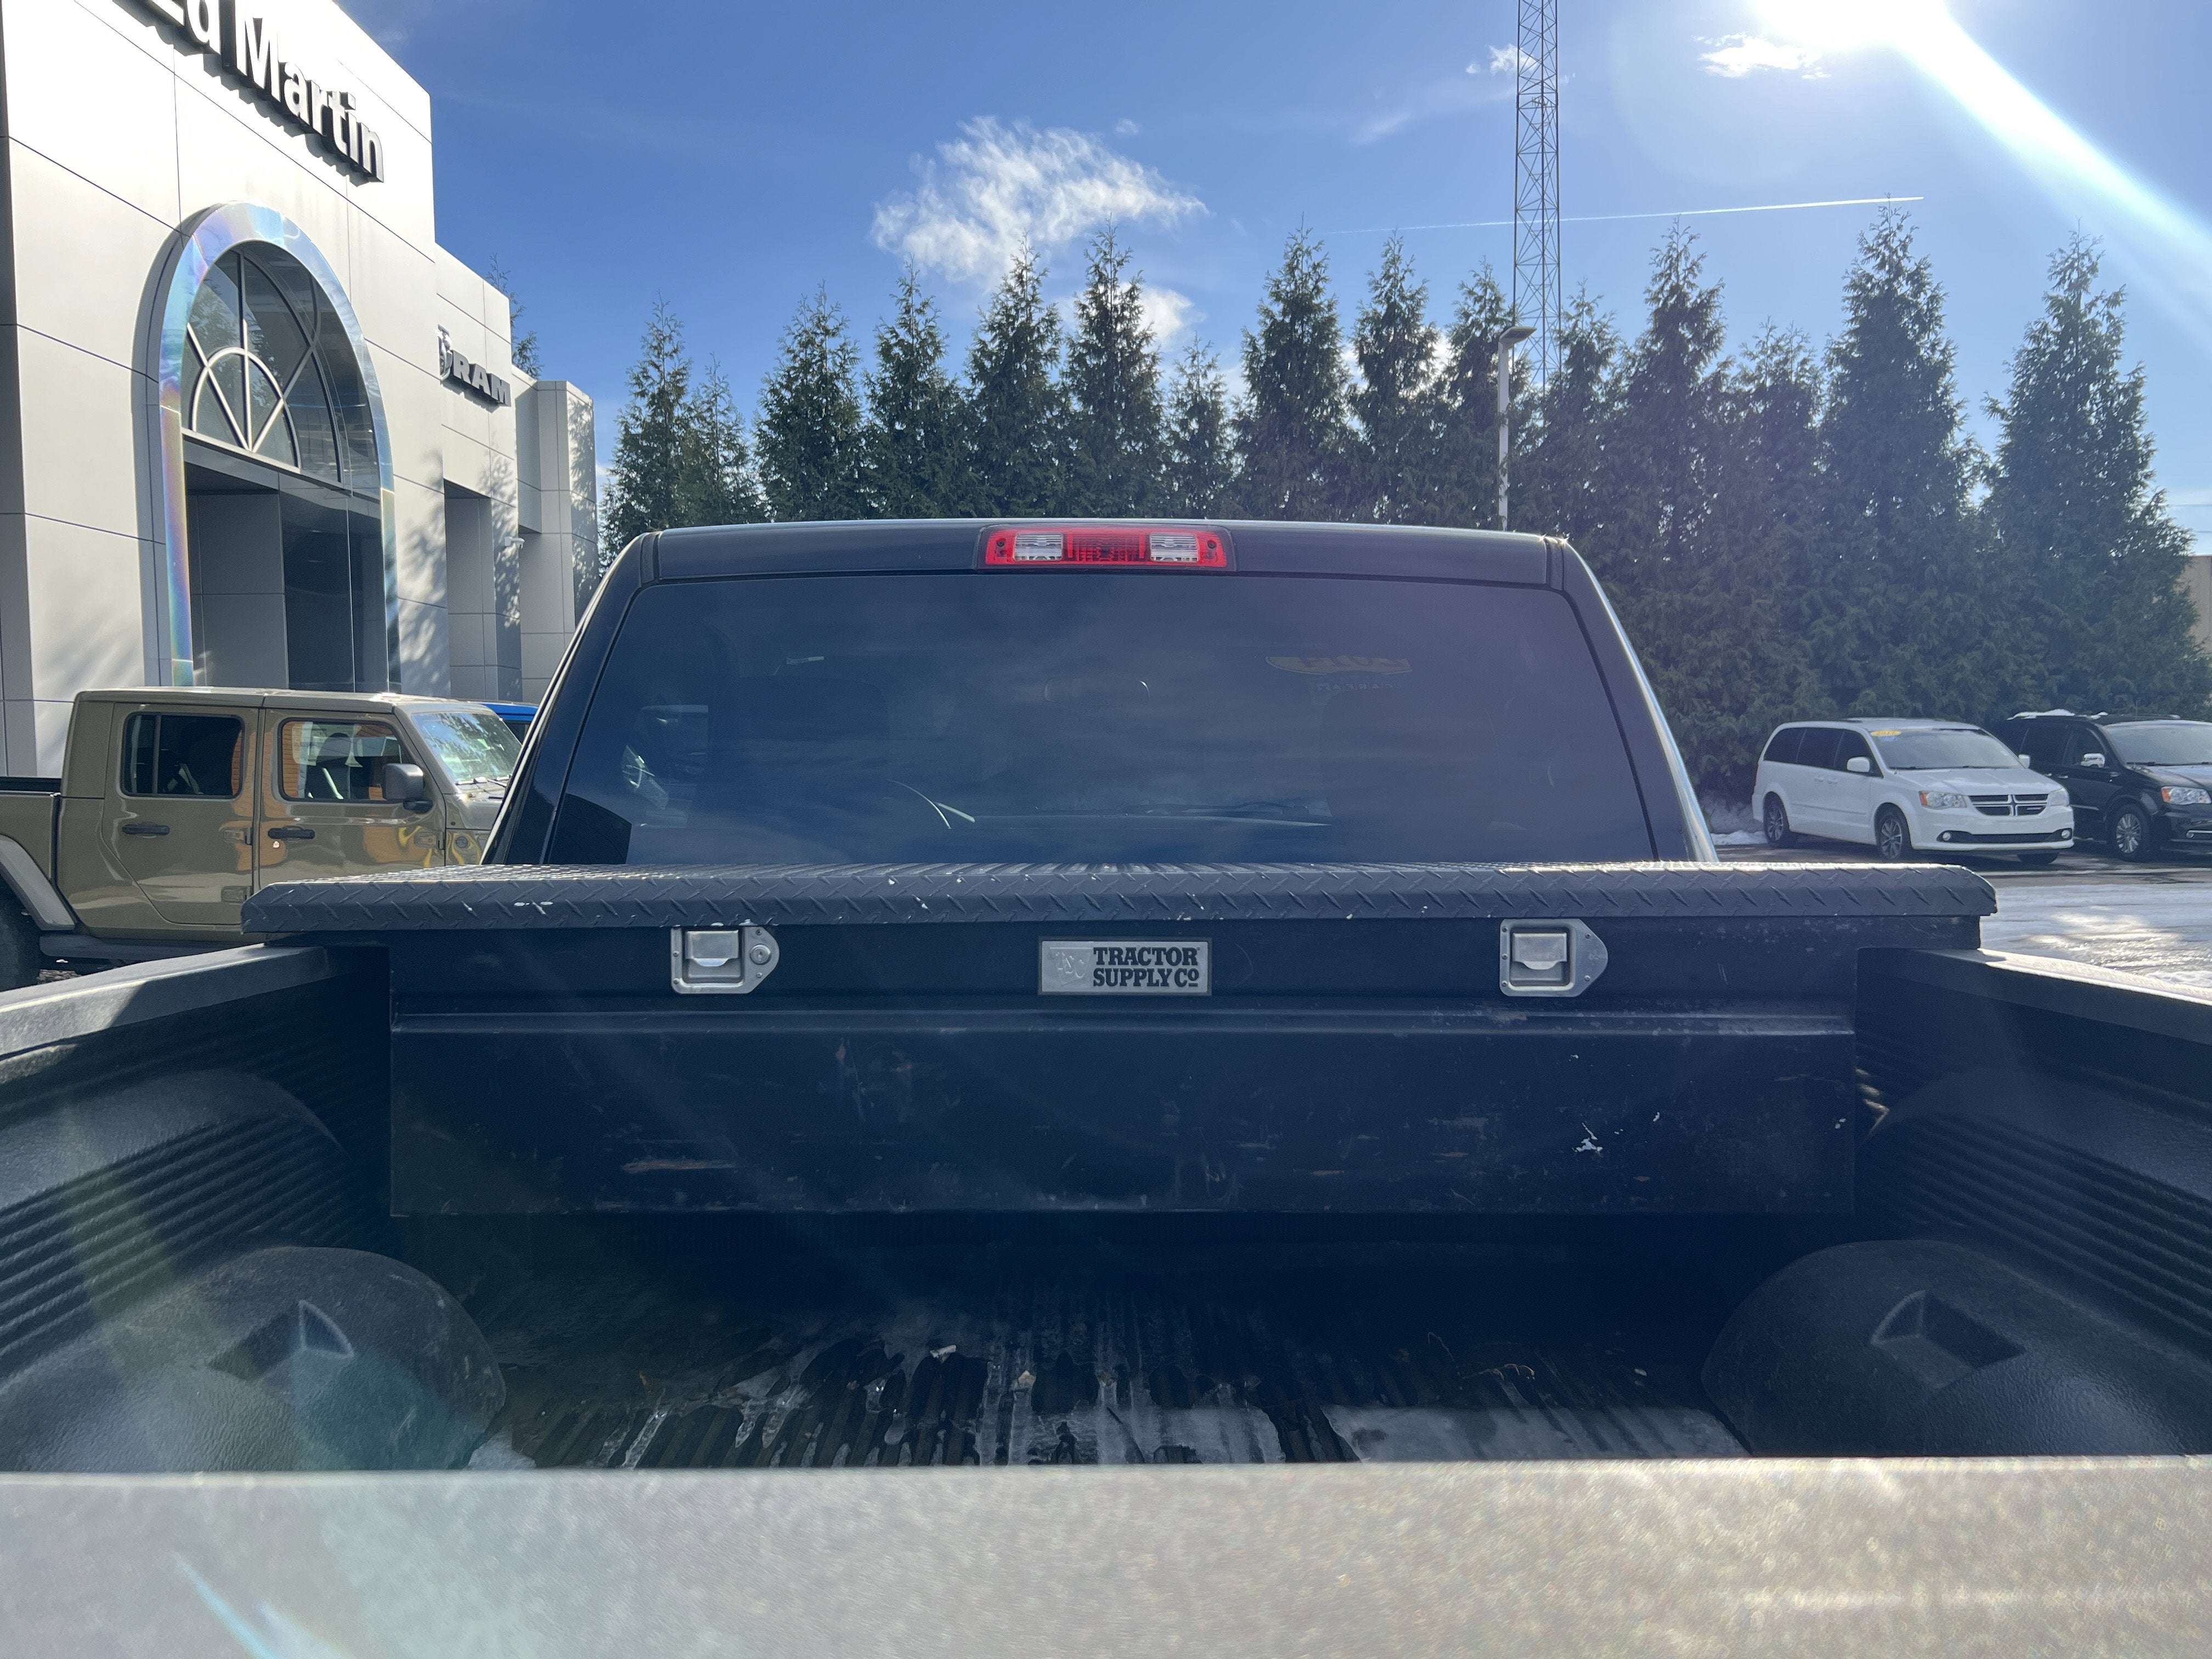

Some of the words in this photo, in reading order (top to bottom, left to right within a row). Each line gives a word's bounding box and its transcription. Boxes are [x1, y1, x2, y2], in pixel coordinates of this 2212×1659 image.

[230, 0, 383, 183] Martin
[452, 349, 511, 407] RAM
[1093, 946, 1198, 966] TRACTOR
[1093, 968, 1172, 987] SUPPLY
